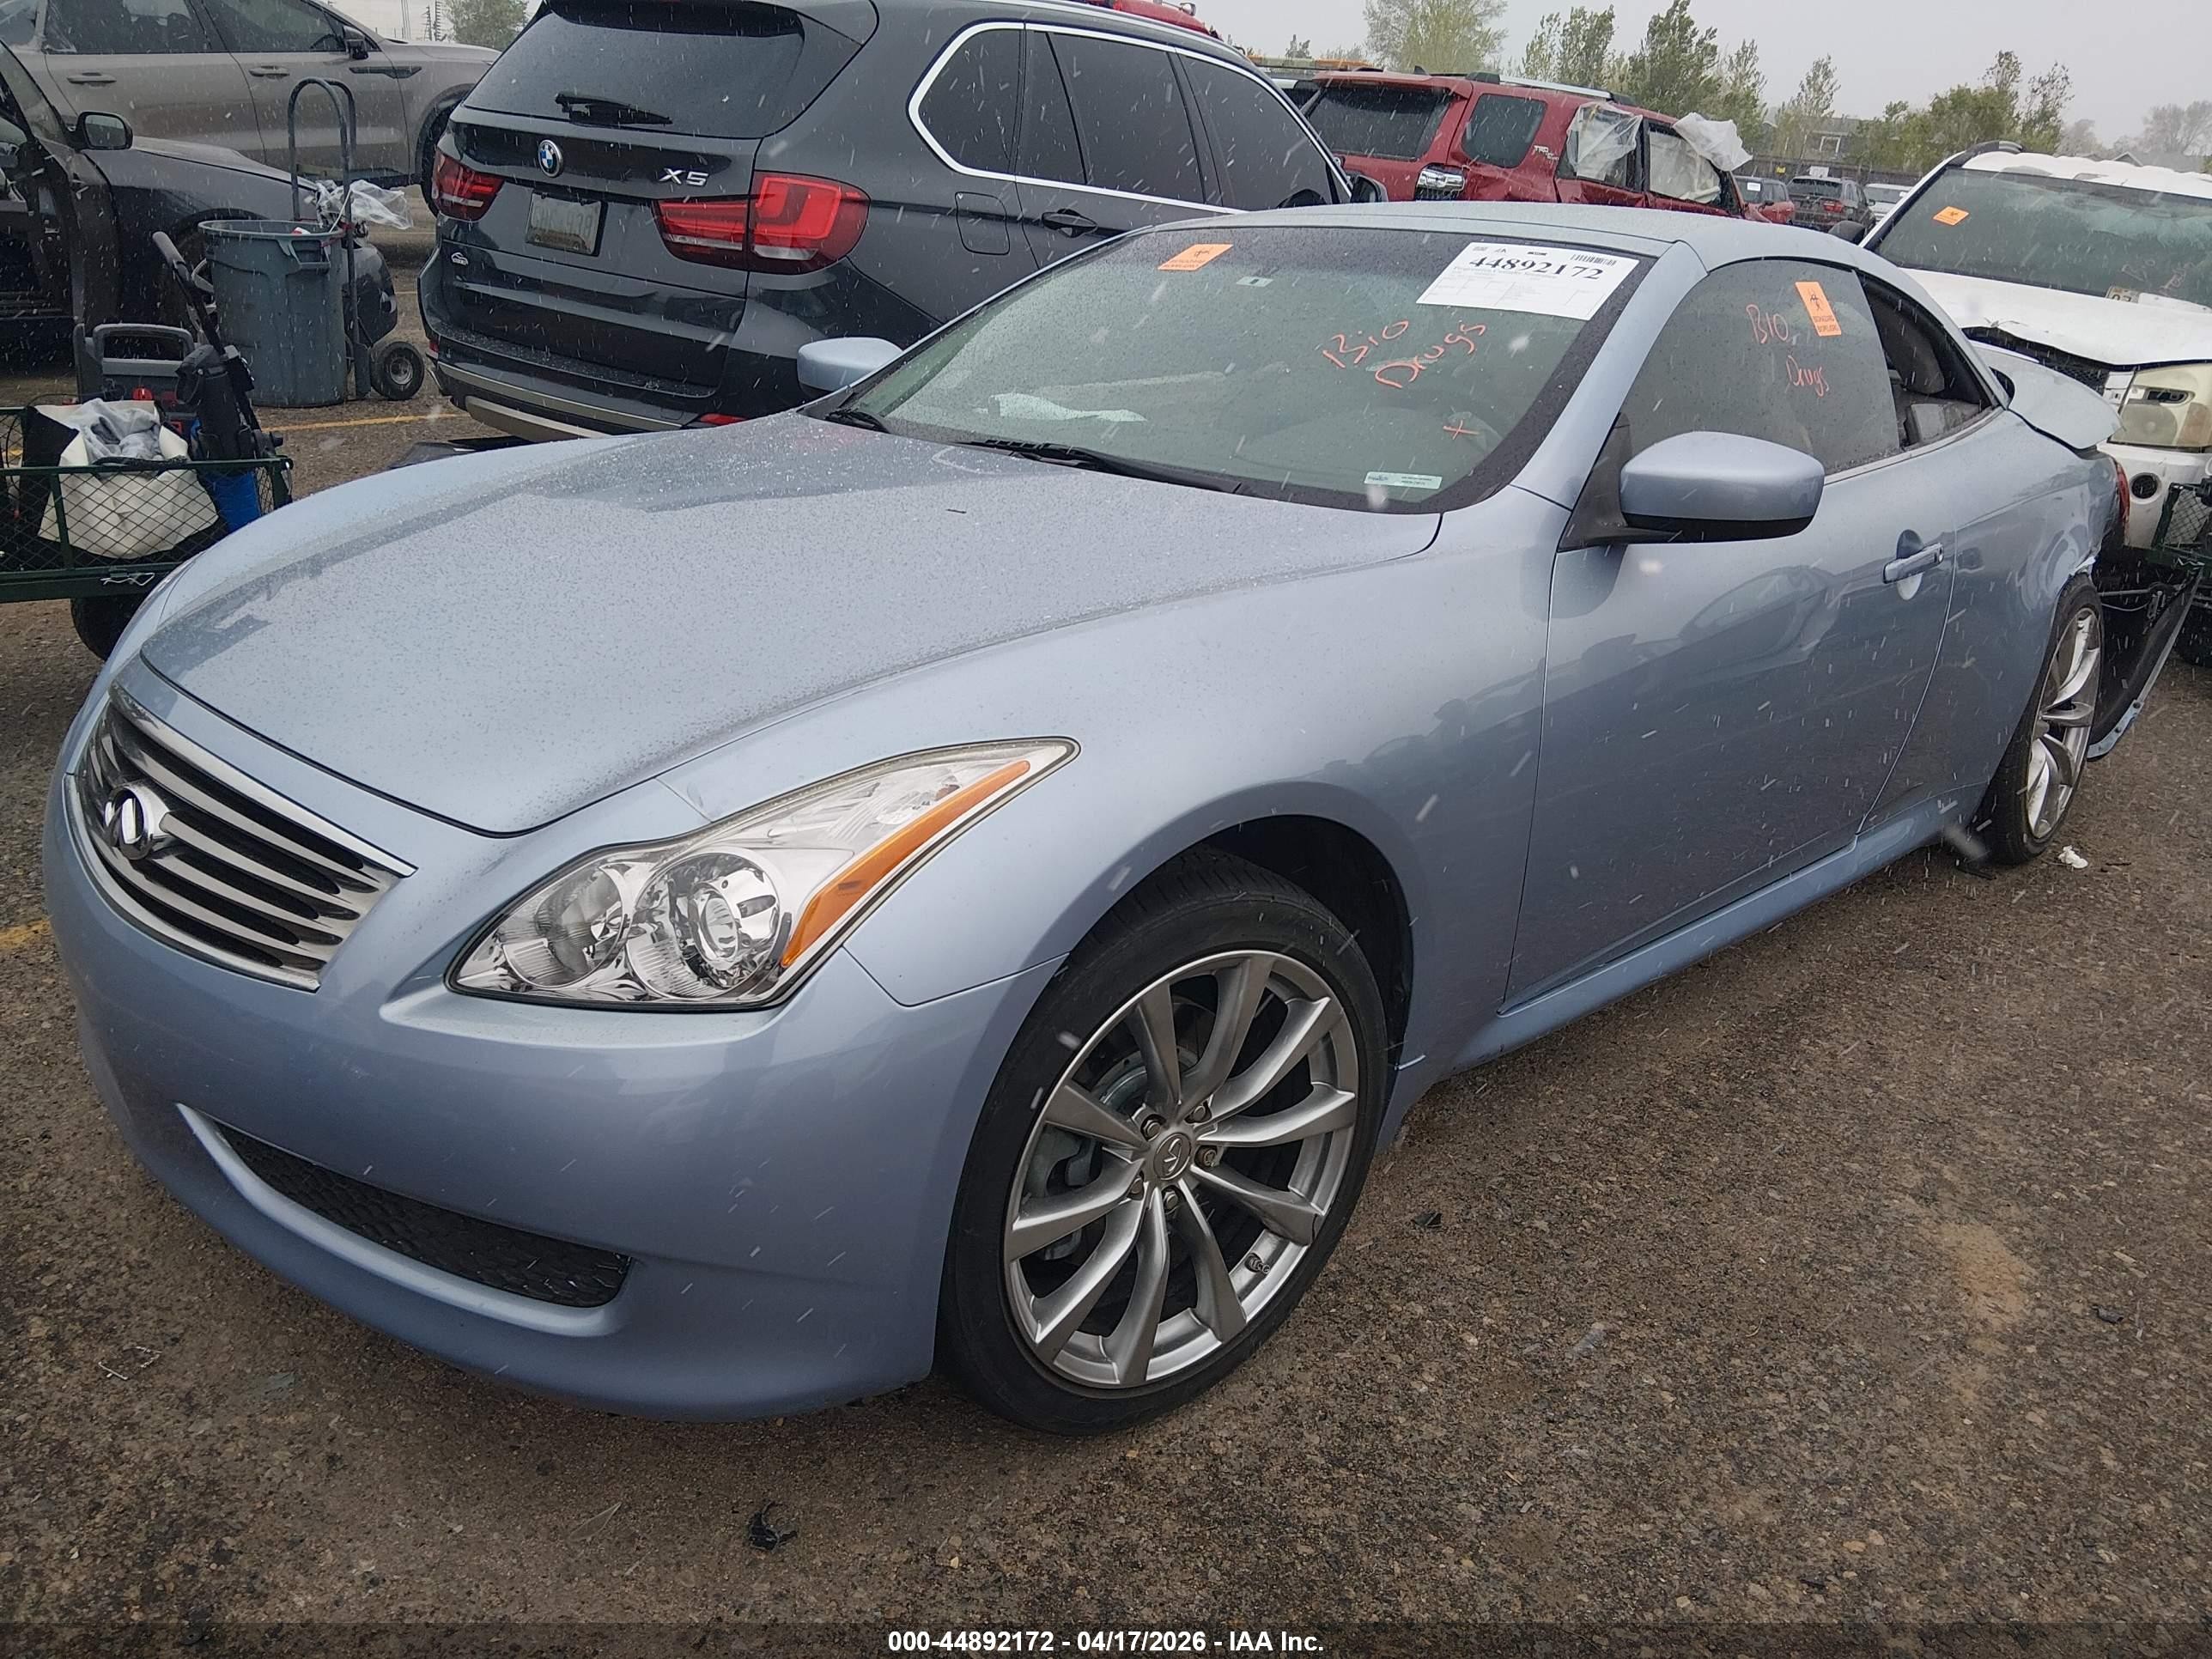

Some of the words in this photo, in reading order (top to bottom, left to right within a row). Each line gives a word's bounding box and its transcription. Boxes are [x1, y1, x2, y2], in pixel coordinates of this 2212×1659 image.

[659, 167, 709, 187] X5
[1469, 256, 1604, 281] 44892172
[1374, 322, 1486, 389] Drugs
[1785, 354, 1830, 398] Drugs
